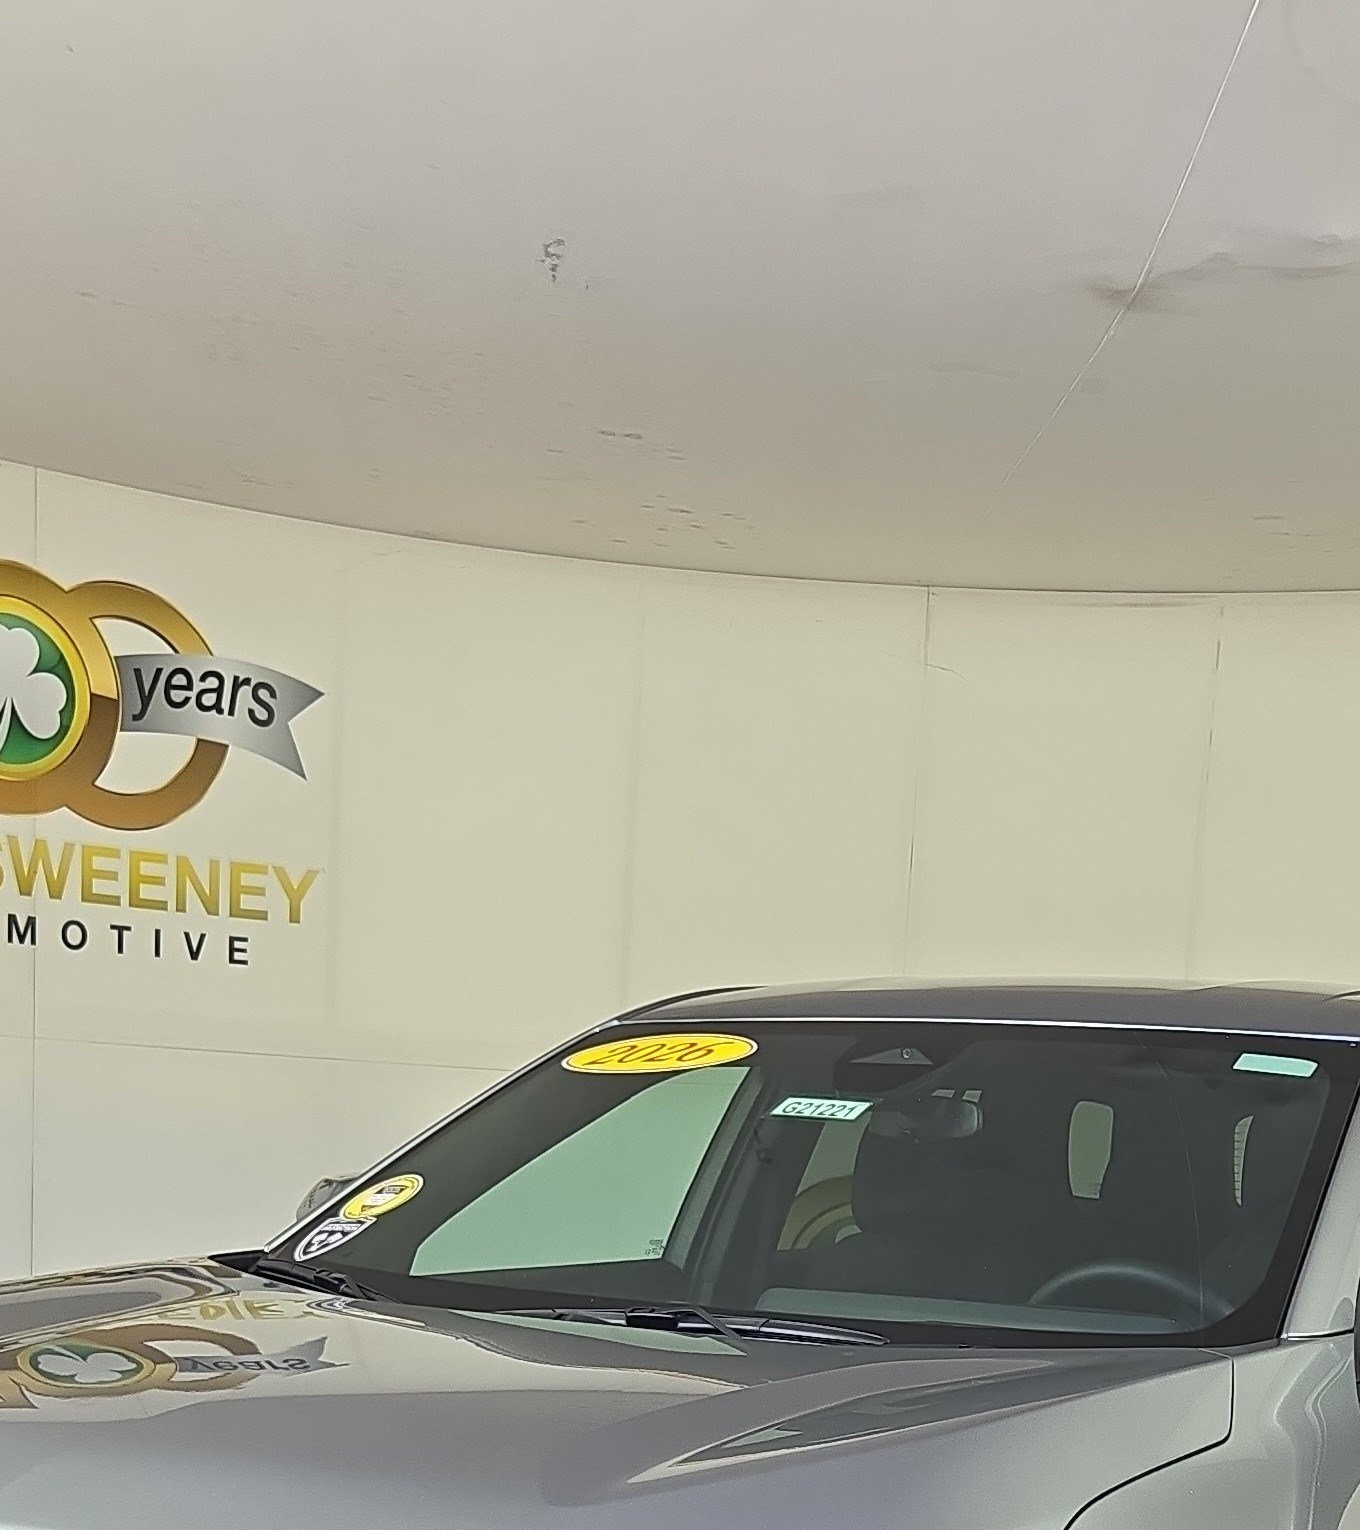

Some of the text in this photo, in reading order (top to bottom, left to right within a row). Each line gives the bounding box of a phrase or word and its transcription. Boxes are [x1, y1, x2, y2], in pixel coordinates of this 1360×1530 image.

[131, 665, 279, 728] years
[582, 1042, 734, 1066] 2026
[780, 1100, 854, 1119] G21221
